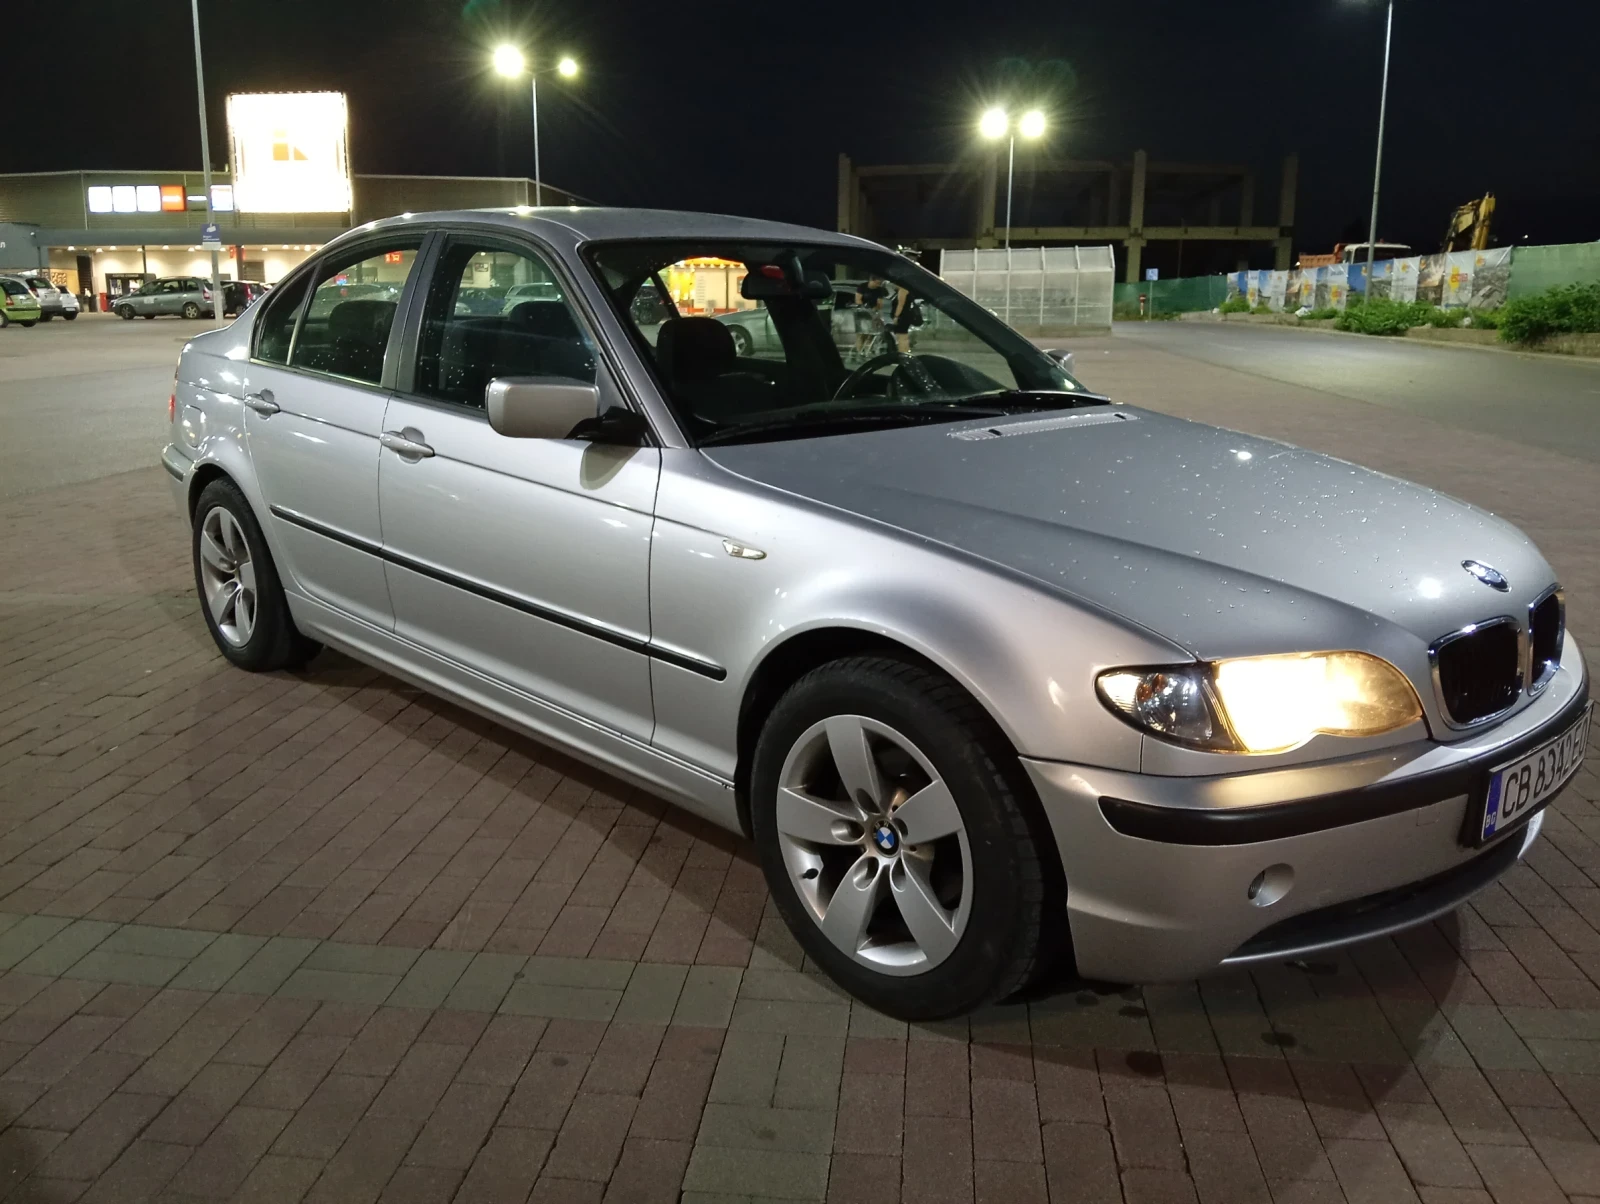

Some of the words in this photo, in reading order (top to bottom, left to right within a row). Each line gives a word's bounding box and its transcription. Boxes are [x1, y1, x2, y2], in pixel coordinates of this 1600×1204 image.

[1502, 764, 1531, 819] CB
[1534, 734, 1571, 798] 8342
[1485, 812, 1496, 827] BG
